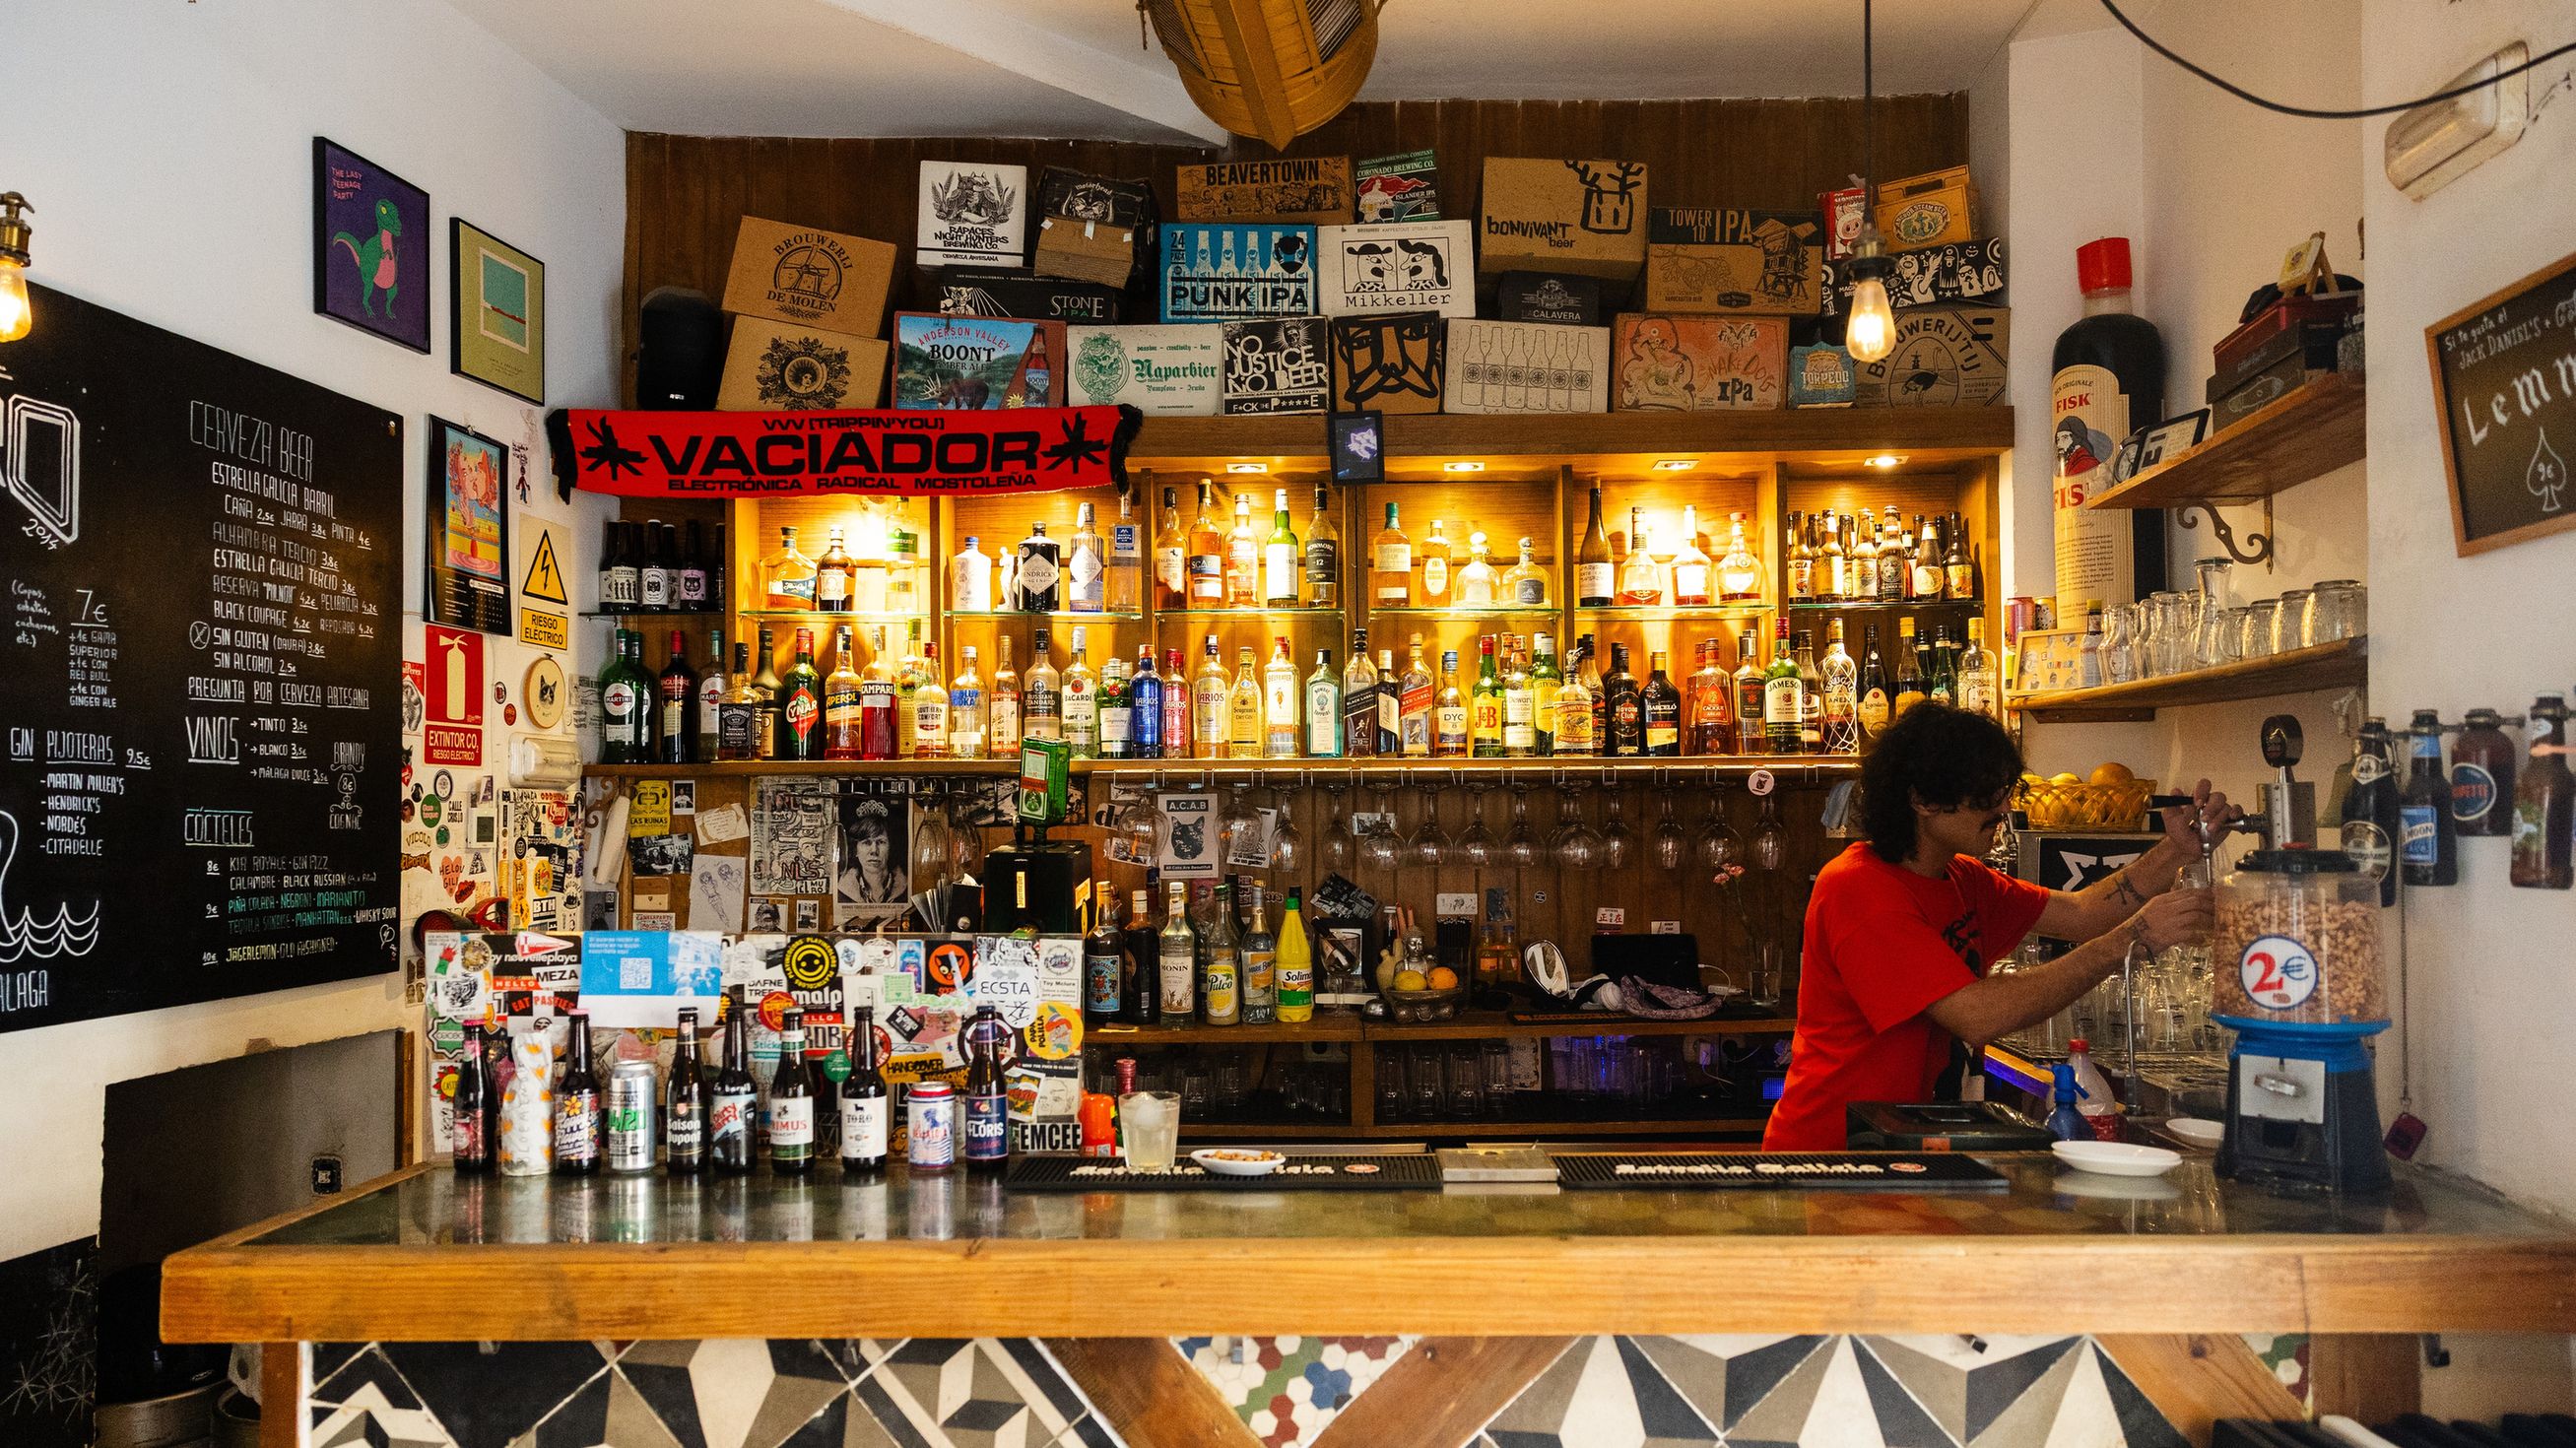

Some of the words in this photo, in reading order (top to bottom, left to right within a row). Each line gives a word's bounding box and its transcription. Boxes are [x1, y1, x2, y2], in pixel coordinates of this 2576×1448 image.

[331, 165, 345, 177] THE
[346, 170, 363, 180] LAST
[1205, 160, 1319, 187] BEAVERTOWN
[1357, 166, 1392, 177] CORONADO
[1394, 162, 1422, 171] BREWING
[331, 177, 363, 190] TEENAGE
[333, 190, 355, 200] PARTY
[1396, 191, 1424, 200] ISLANDER
[949, 226, 995, 235] RAPACES
[1669, 209, 1712, 228] TOWER
[1714, 210, 1753, 243] IPA
[1692, 225, 1706, 242] 10
[934, 230, 963, 241] NIGHT
[965, 233, 1009, 244] HUNTERS
[944, 240, 983, 249] BREWING
[1170, 232, 1185, 248] 24
[1549, 236, 1575, 249] beer
[774, 232, 853, 270] BROUWERIJ
[1170, 252, 1185, 261] PACK
[766, 291, 785, 302] DE
[789, 296, 837, 313] MOLEN
[1050, 296, 1104, 318] STONE
[1171, 287, 1253, 309] PUNK
[1262, 287, 1308, 308] IPA
[1345, 293, 1450, 307] Mikkeller
[1533, 310, 1581, 321] CALAVERA
[918, 327, 970, 346] ANDERSON
[975, 329, 1011, 351] VALLEY
[2445, 335, 2456, 352] Si
[2471, 315, 2495, 343] gusta
[2460, 344, 2486, 369] JACK
[2487, 316, 2542, 356] DANIEL'S
[930, 344, 995, 362] BOONT
[1223, 335, 1263, 361] NO
[1132, 359, 1218, 381] Naparbier
[1227, 345, 1315, 379] JUSTICE
[1228, 374, 1268, 393] NO
[1275, 362, 1327, 390] BEER
[1697, 354, 1742, 392] SNAKE
[1745, 354, 1776, 392] DOG
[1801, 371, 1849, 384] TORPEDO
[2063, 379, 2093, 389] ORIGINALE
[2056, 393, 2091, 414] FISK
[190, 400, 272, 467] CERVEZA
[281, 427, 313, 483] BEER
[647, 430, 1041, 477] VACIADOR
[2538, 462, 2554, 482] 9€
[213, 461, 260, 494] ESTRELLA
[263, 474, 297, 507] GALICIA
[303, 487, 337, 519] BARRIL
[668, 477, 803, 492] ELECTRÓNICA
[817, 476, 900, 490] RADICAL
[914, 471, 1036, 490] MOSTOLEÑA
[225, 494, 253, 518] CAÑA
[281, 510, 307, 531] JARRA
[332, 523, 355, 543] PINTA
[22, 518, 58, 550] 2014
[213, 521, 276, 554] ALHAMBRA
[282, 540, 316, 565] TERCIO
[214, 549, 265, 572] ESTRELLA
[270, 559, 303, 581] GALICIA
[308, 568, 337, 591] TERCIO
[213, 574, 259, 598] RESERVA
[76, 589, 107, 623] 7€
[214, 600, 245, 622] BLACK
[248, 605, 288, 628] COUPAGE
[532, 614, 558, 629] RIESGO
[91, 630, 117, 645] GAMA
[214, 627, 231, 646] SIN
[234, 629, 269, 651] GLUTEN
[525, 625, 563, 645] ELÉCTRICO
[69, 643, 118, 660] SUPERIOR
[91, 659, 108, 670] CON
[214, 652, 230, 669] SIN
[233, 653, 275, 674] ALCOHOL
[69, 669, 87, 681] RED
[90, 670, 111, 682] BULL
[1825, 676, 1854, 691] BRUGAL
[90, 685, 107, 695] CON
[188, 676, 245, 700] PREGUNTA
[253, 680, 273, 700] POR
[281, 683, 321, 703] CERVEZA
[327, 686, 369, 707] ARTESANA
[861, 684, 894, 694] CAMPARI
[1768, 680, 1801, 692] JAMESON
[69, 695, 100, 707] GINGER
[102, 697, 117, 708] ALE
[826, 692, 857, 706] APEROL
[1136, 697, 1158, 706] LARIOS
[1164, 700, 1186, 709] LARIOS
[1197, 692, 1224, 702] LARIOS
[1346, 697, 1359, 706] BLACK
[1360, 692, 1374, 702] LABEL
[1414, 692, 1430, 702] LABEL
[786, 699, 818, 723] CYNAR
[1475, 706, 1497, 729] J&B
[10, 727, 34, 757] GIN
[46, 730, 113, 762] PIJOTERAS
[185, 716, 239, 760] VINOS
[258, 717, 286, 732] TINTO
[429, 730, 464, 748] EXTINTOR
[259, 744, 288, 757] BLANCO
[333, 742, 365, 765] BRANDY
[432, 749, 450, 759] RIESGO
[450, 750, 474, 761] ELECTRICO
[258, 765, 289, 780] MÁLAGA
[46, 773, 83, 790] MARTIN
[87, 774, 124, 795] MILLER'S
[47, 795, 100, 814] HENDRICK'S
[1168, 801, 1207, 811] A.C.A.B
[184, 807, 253, 845] CÓCTELES
[329, 814, 362, 830] COGNAC
[2406, 823, 2434, 838] MOON
[46, 838, 103, 856] CITADELLE
[230, 857, 247, 872] KIR
[253, 856, 287, 872] ROYALE
[293, 856, 307, 870] GIN
[309, 855, 329, 870] FIZZ
[230, 875, 276, 890] CALAMBRE
[283, 875, 310, 889] BLACK
[313, 873, 346, 887] RUSSIAN
[229, 896, 246, 914] PIÑA
[248, 895, 275, 911] COLADA
[280, 892, 312, 908] NEGRONI
[316, 890, 365, 907] MARIANITO
[533, 898, 556, 912] BTH
[296, 910, 340, 928] MANHATTAN
[356, 907, 380, 923] WHISKY
[297, 937, 335, 956] FASHIONED
[536, 969, 578, 982] MEZA
[1209, 974, 1232, 991] Pulco
[2246, 952, 2310, 995] 2€
[980, 981, 1031, 995] ECSTA
[512, 997, 530, 1013] EAT
[534, 995, 576, 1012] PASTIES
[790, 986, 842, 1012] malp
[1029, 1015, 1038, 1043] PAPA
[667, 1118, 701, 1130] Saison
[846, 1114, 873, 1124] TORO
[667, 1132, 701, 1144] Dupont
[967, 1120, 1004, 1138] FLORIS
[1020, 1124, 1082, 1151] EMCEE
[1754, 1162, 1884, 1174] Galicia
